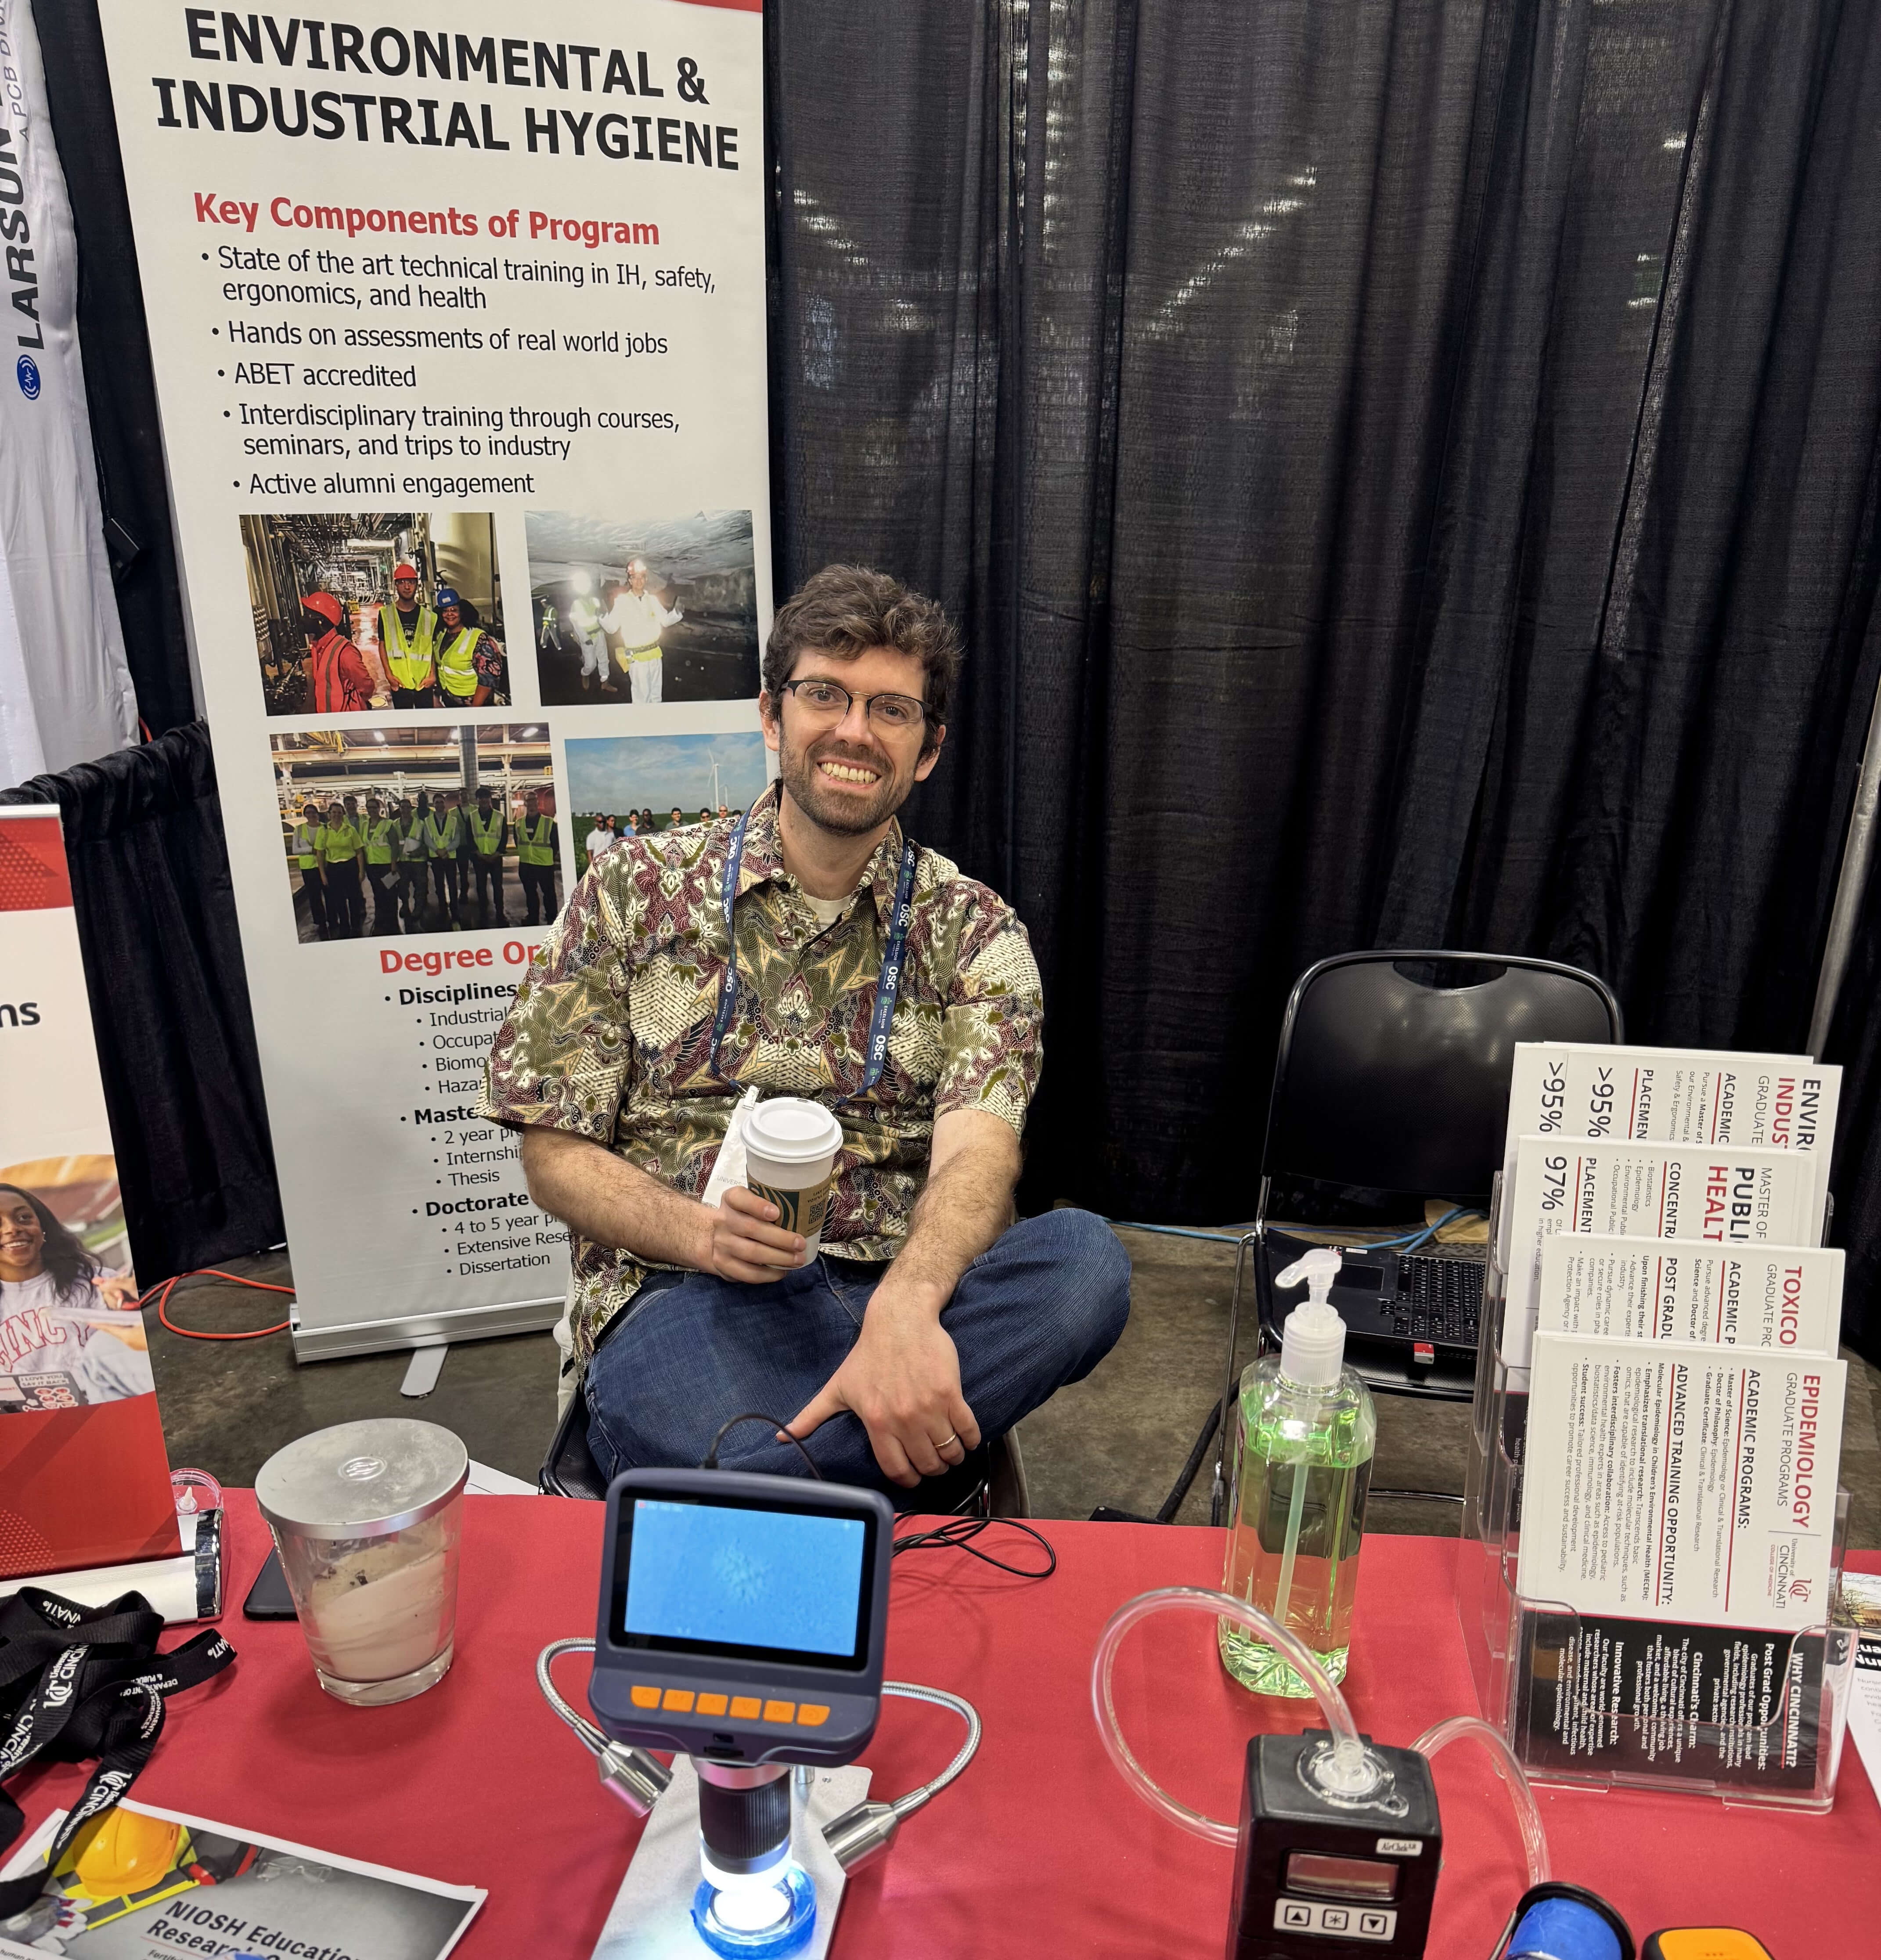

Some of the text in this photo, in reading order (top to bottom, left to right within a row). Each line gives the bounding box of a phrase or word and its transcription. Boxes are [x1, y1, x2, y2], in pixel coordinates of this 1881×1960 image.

[185, 8, 709, 104] ENVIRONMENTAL &
[4, 66, 27, 118] PCB
[152, 77, 739, 170] INDUSTRIAL HYGIENE
[194, 192, 659, 249] Key Components of Program
[219, 245, 714, 293] State of the art technical training in IH, safety,
[223, 283, 486, 310] ergonomics, and health
[229, 321, 667, 357] Hands on assessments of real world jobs
[235, 363, 416, 387] ABET accredited
[239, 404, 679, 432] Interdisciplinary training through courses,
[244, 434, 570, 460] seminars, and trips to industry
[250, 472, 535, 497] Active alumni engagement
[728, 836, 737, 860] OSC
[898, 903, 910, 927] OSC
[380, 948, 493, 976] Degree
[725, 967, 734, 992] OSC
[885, 966, 898, 991] OSC
[873, 1034, 886, 1061] OSC
[1539, 1062, 1565, 1132] >95%
[1588, 1067, 1614, 1137] >95%
[1636, 1070, 1654, 1139] PLACEMEN
[1719, 1073, 1736, 1143] ACADEMIC
[1752, 1076, 1769, 1144] GRADUATE
[1796, 1080, 1821, 1147] ENVIR
[445, 1131, 454, 1144] 2
[460, 1128, 494, 1146] year
[448, 1170, 500, 1186] Thesis
[1542, 1157, 1567, 1210] 97%
[1581, 1158, 1596, 1233] PLACEMENT
[1632, 1166, 1643, 1212] Epidemiology
[1645, 1167, 1654, 1207] Biostatistics
[426, 1193, 529, 1216] Doctorate
[455, 1222, 465, 1234] 4
[469, 1221, 486, 1232] to
[491, 1217, 500, 1230] 5
[505, 1215, 539, 1231] year
[1703, 1166, 1728, 1242] HEALT
[1730, 1167, 1755, 1238] PUBLI
[1756, 1168, 1772, 1238] MASTER OF
[458, 1236, 530, 1255] Extensive
[460, 1255, 550, 1275] Dissertation
[1617, 1260, 1626, 1290] industry.
[1665, 1258, 1677, 1292] POST
[1726, 1261, 1741, 1333] ACADEMIC
[1763, 1264, 1777, 1323] GRADUATE
[1719, 1439, 1730, 1482] Epidemiology
[1738, 1369, 1760, 1528] ACADEMIC PROGRAMS:
[1777, 1373, 1797, 1506] GRADUATE PROGRAMS
[1793, 1375, 1820, 1528] EPIDEMIOLOGY
[1662, 1364, 1688, 1604] ADVANCED TRAINING OPPORTUNITY:
[1715, 1525, 1723, 1566] Translational
[1789, 1538, 1798, 1568] University
[1776, 1546, 1790, 1608] CINCINNATI
[1553, 1683, 1564, 1731] epidemiology.
[1786, 1651, 1803, 1767] WHY CINCINNATI?
[165, 1900, 247, 1937] NIOSH
